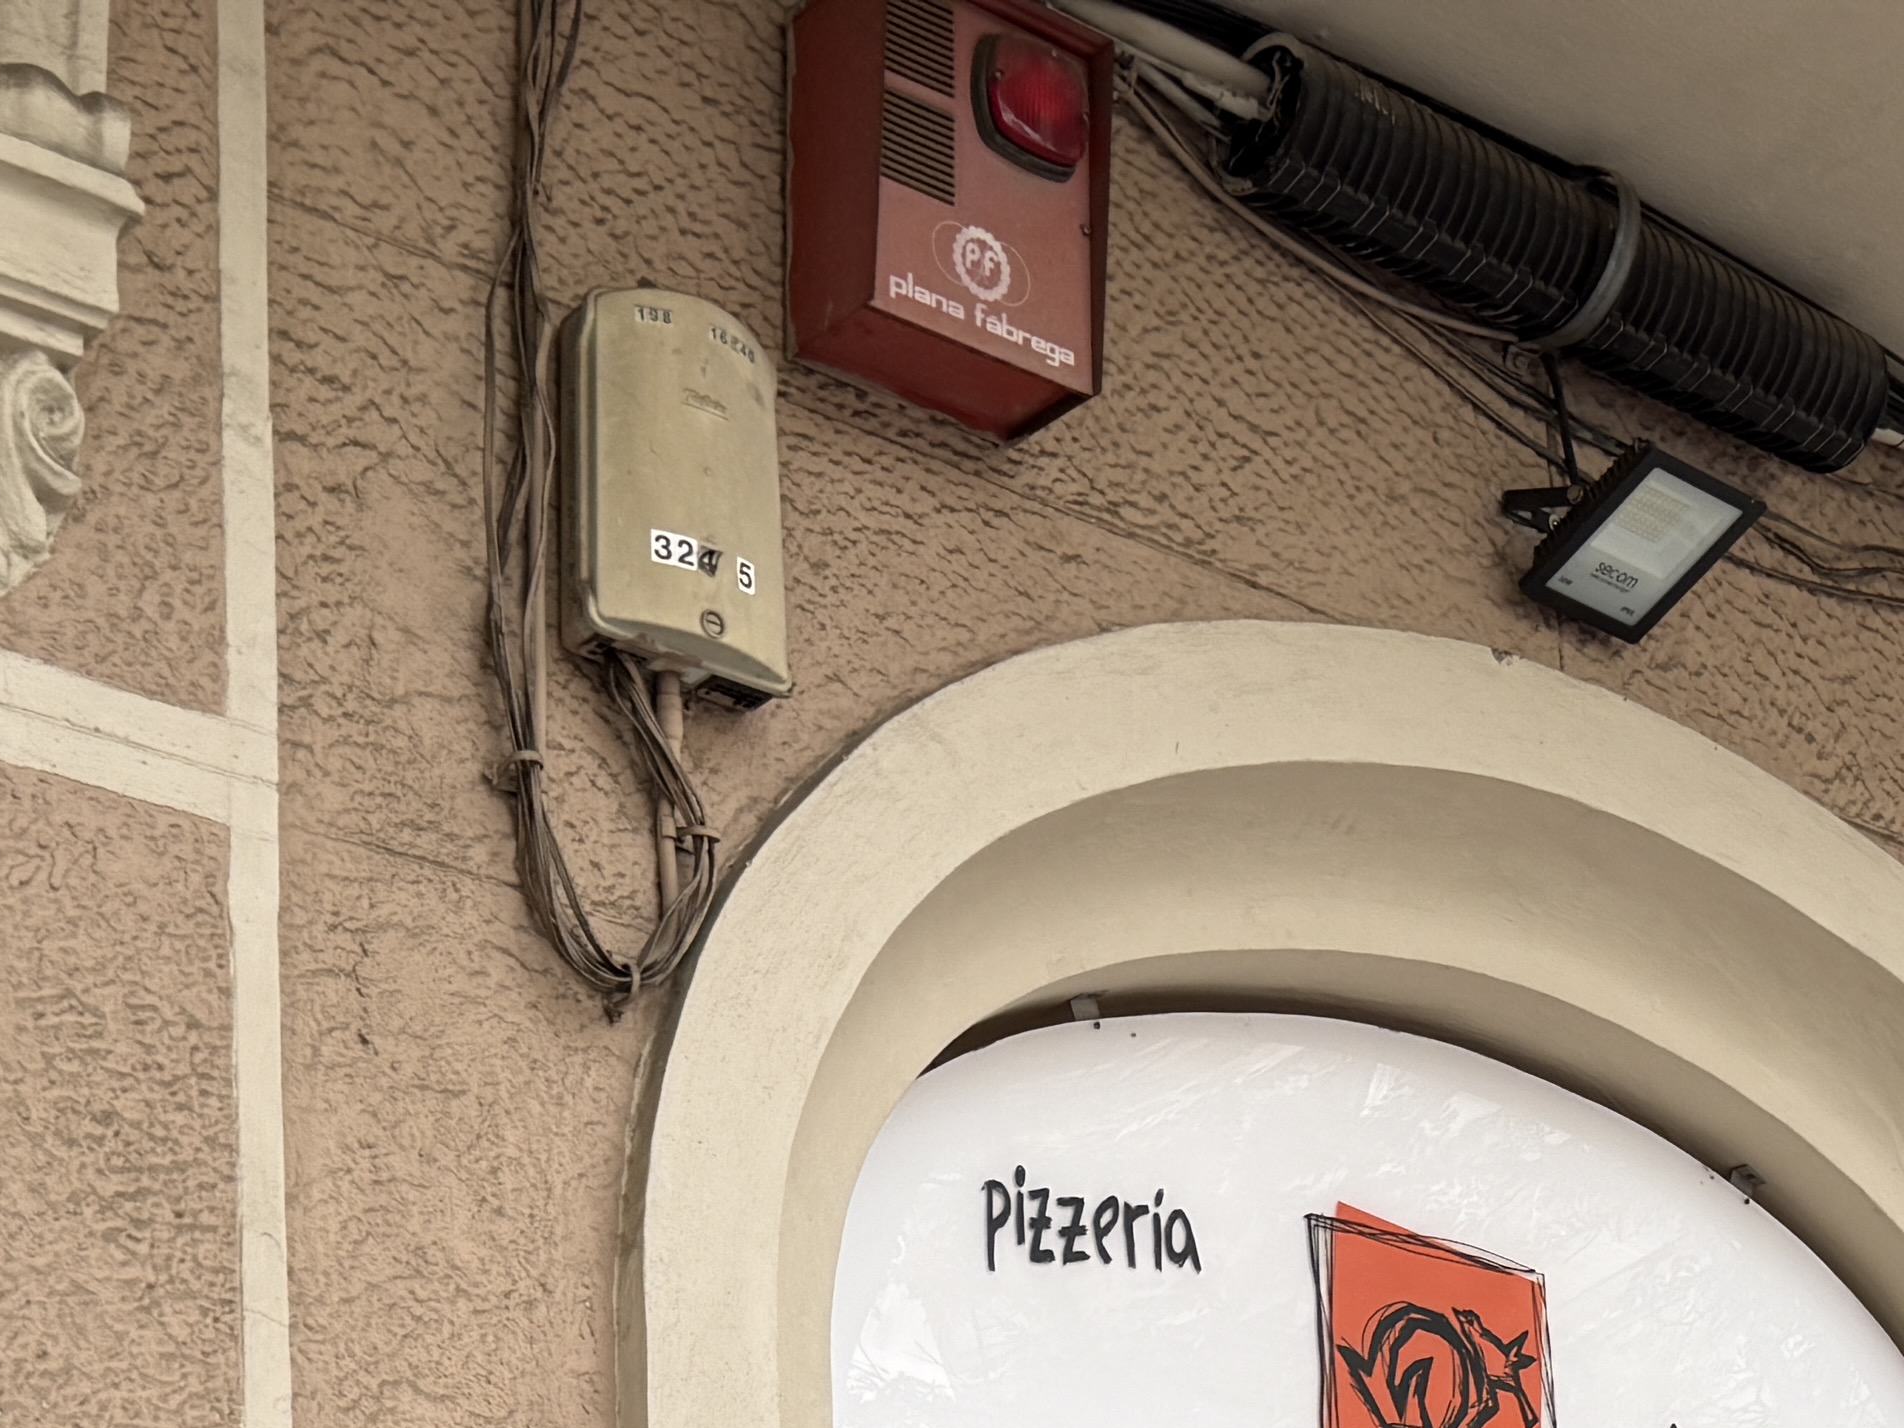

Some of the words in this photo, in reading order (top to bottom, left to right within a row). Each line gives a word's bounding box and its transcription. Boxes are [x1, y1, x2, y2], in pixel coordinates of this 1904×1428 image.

[889, 272, 965, 320] plana
[974, 303, 1075, 367] fabrega
[738, 562, 753, 590] 5
